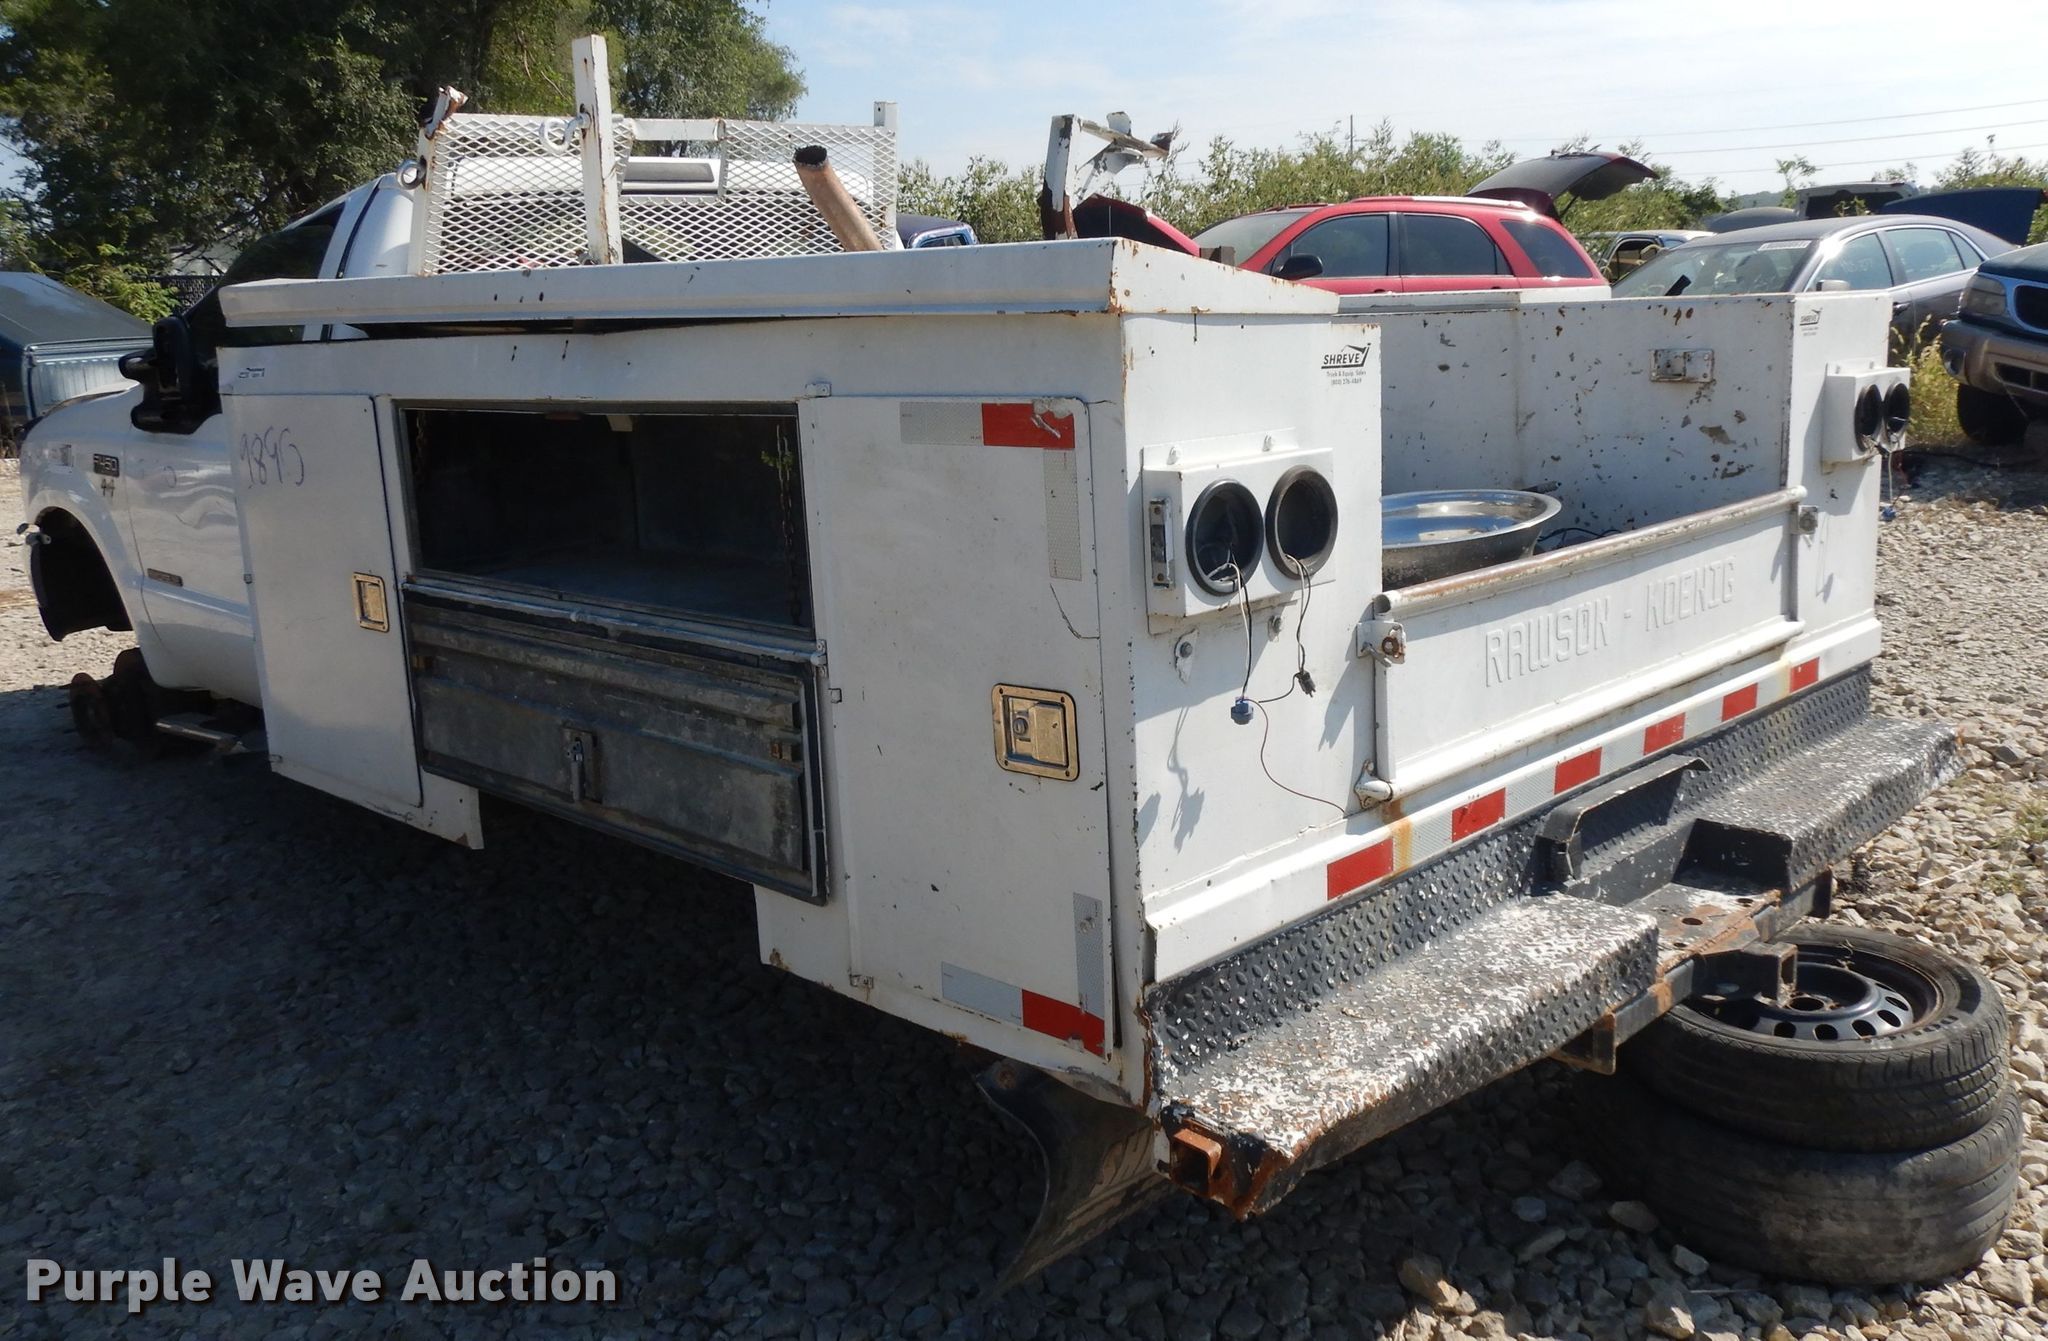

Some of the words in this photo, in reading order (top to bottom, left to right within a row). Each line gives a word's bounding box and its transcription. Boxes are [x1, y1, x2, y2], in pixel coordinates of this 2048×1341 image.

[1323, 353, 1360, 365] SHREVE
[1485, 598, 1609, 687] RAWSON
[1645, 556, 1736, 631] KOENIG
